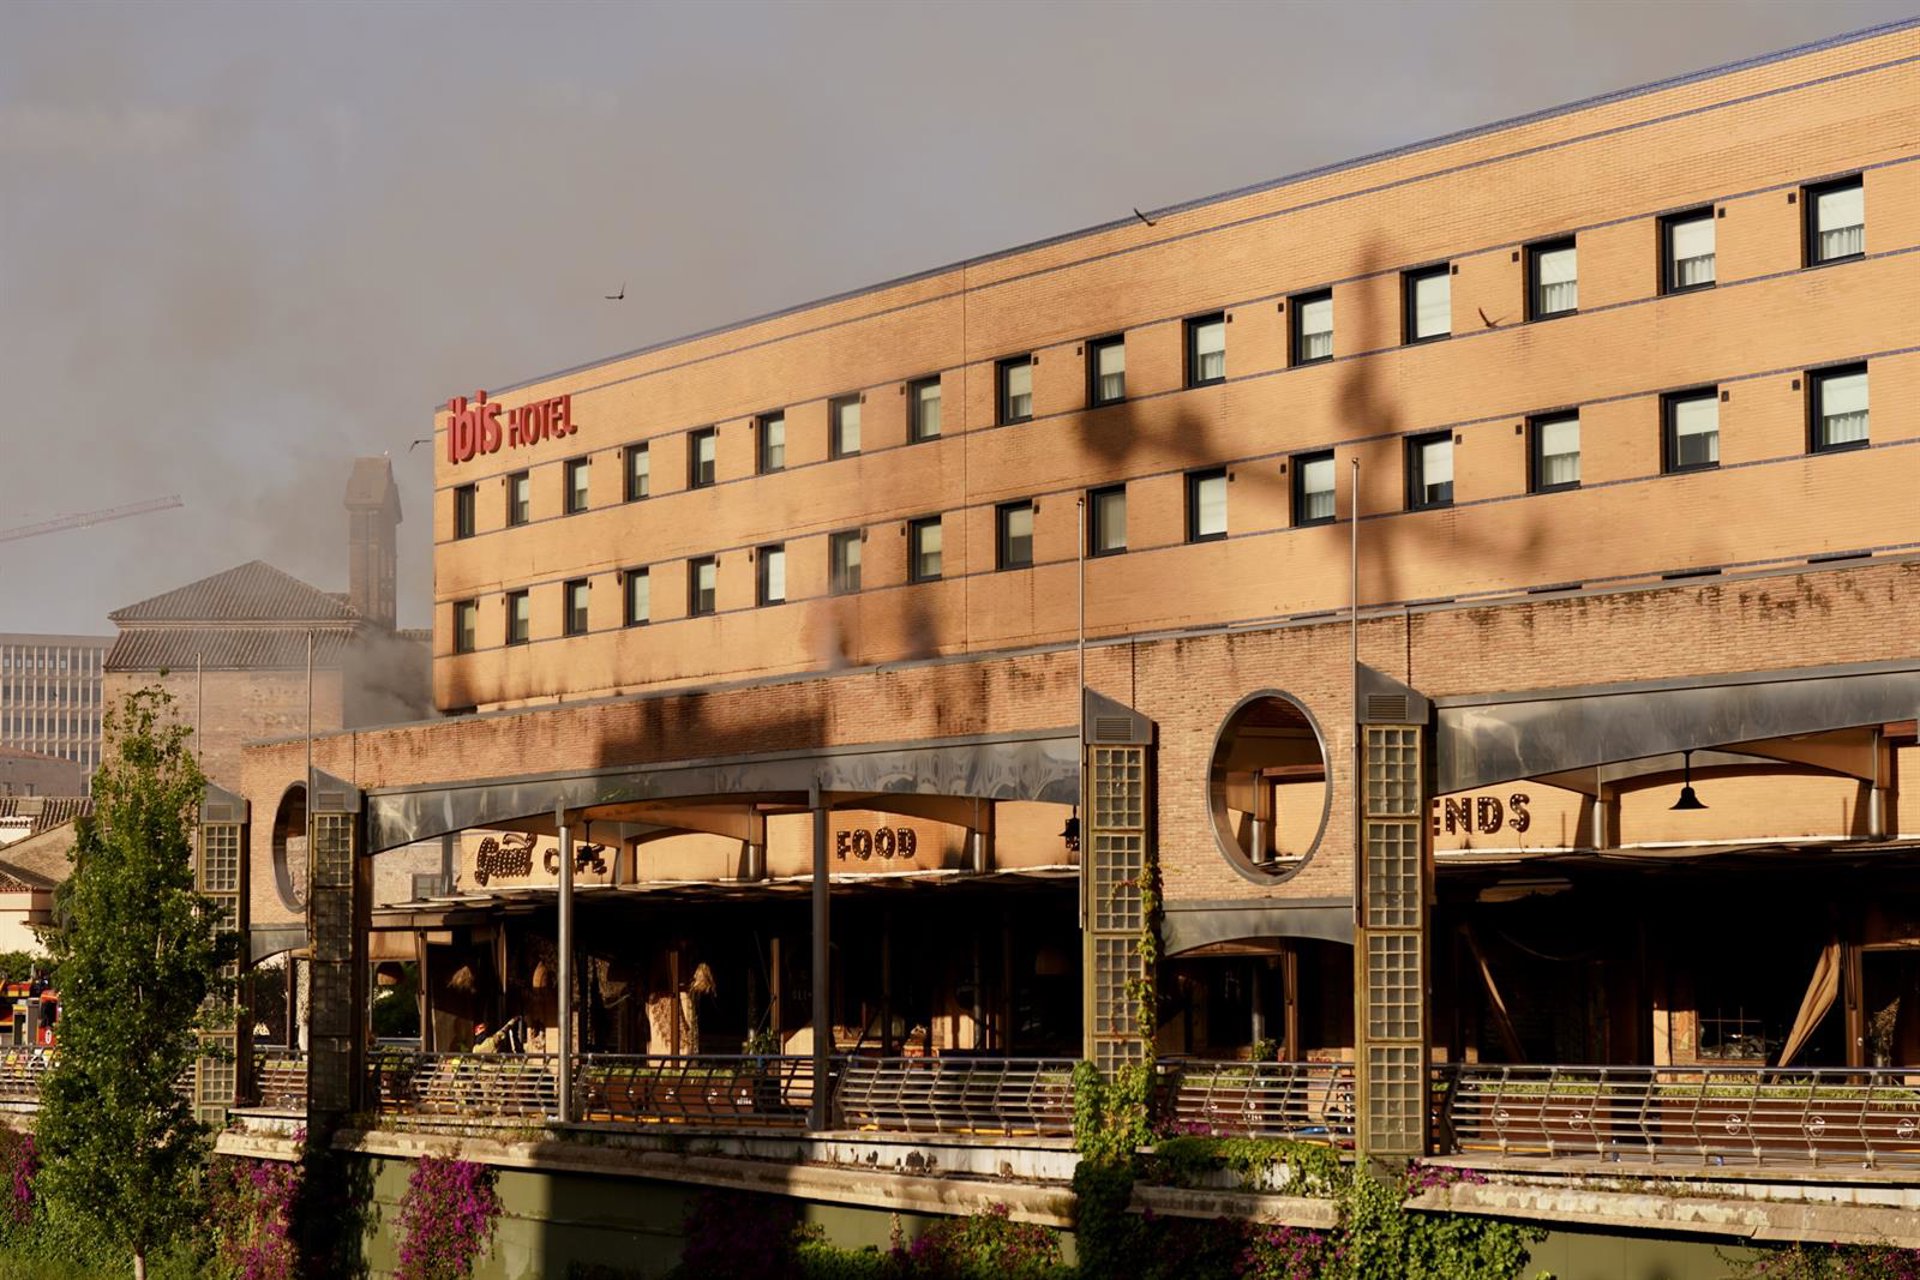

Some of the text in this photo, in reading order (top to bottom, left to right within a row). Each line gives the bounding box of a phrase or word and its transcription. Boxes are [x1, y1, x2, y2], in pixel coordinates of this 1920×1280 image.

[447, 390, 578, 465] ibis HOTEL
[836, 827, 917, 861] FOOD
